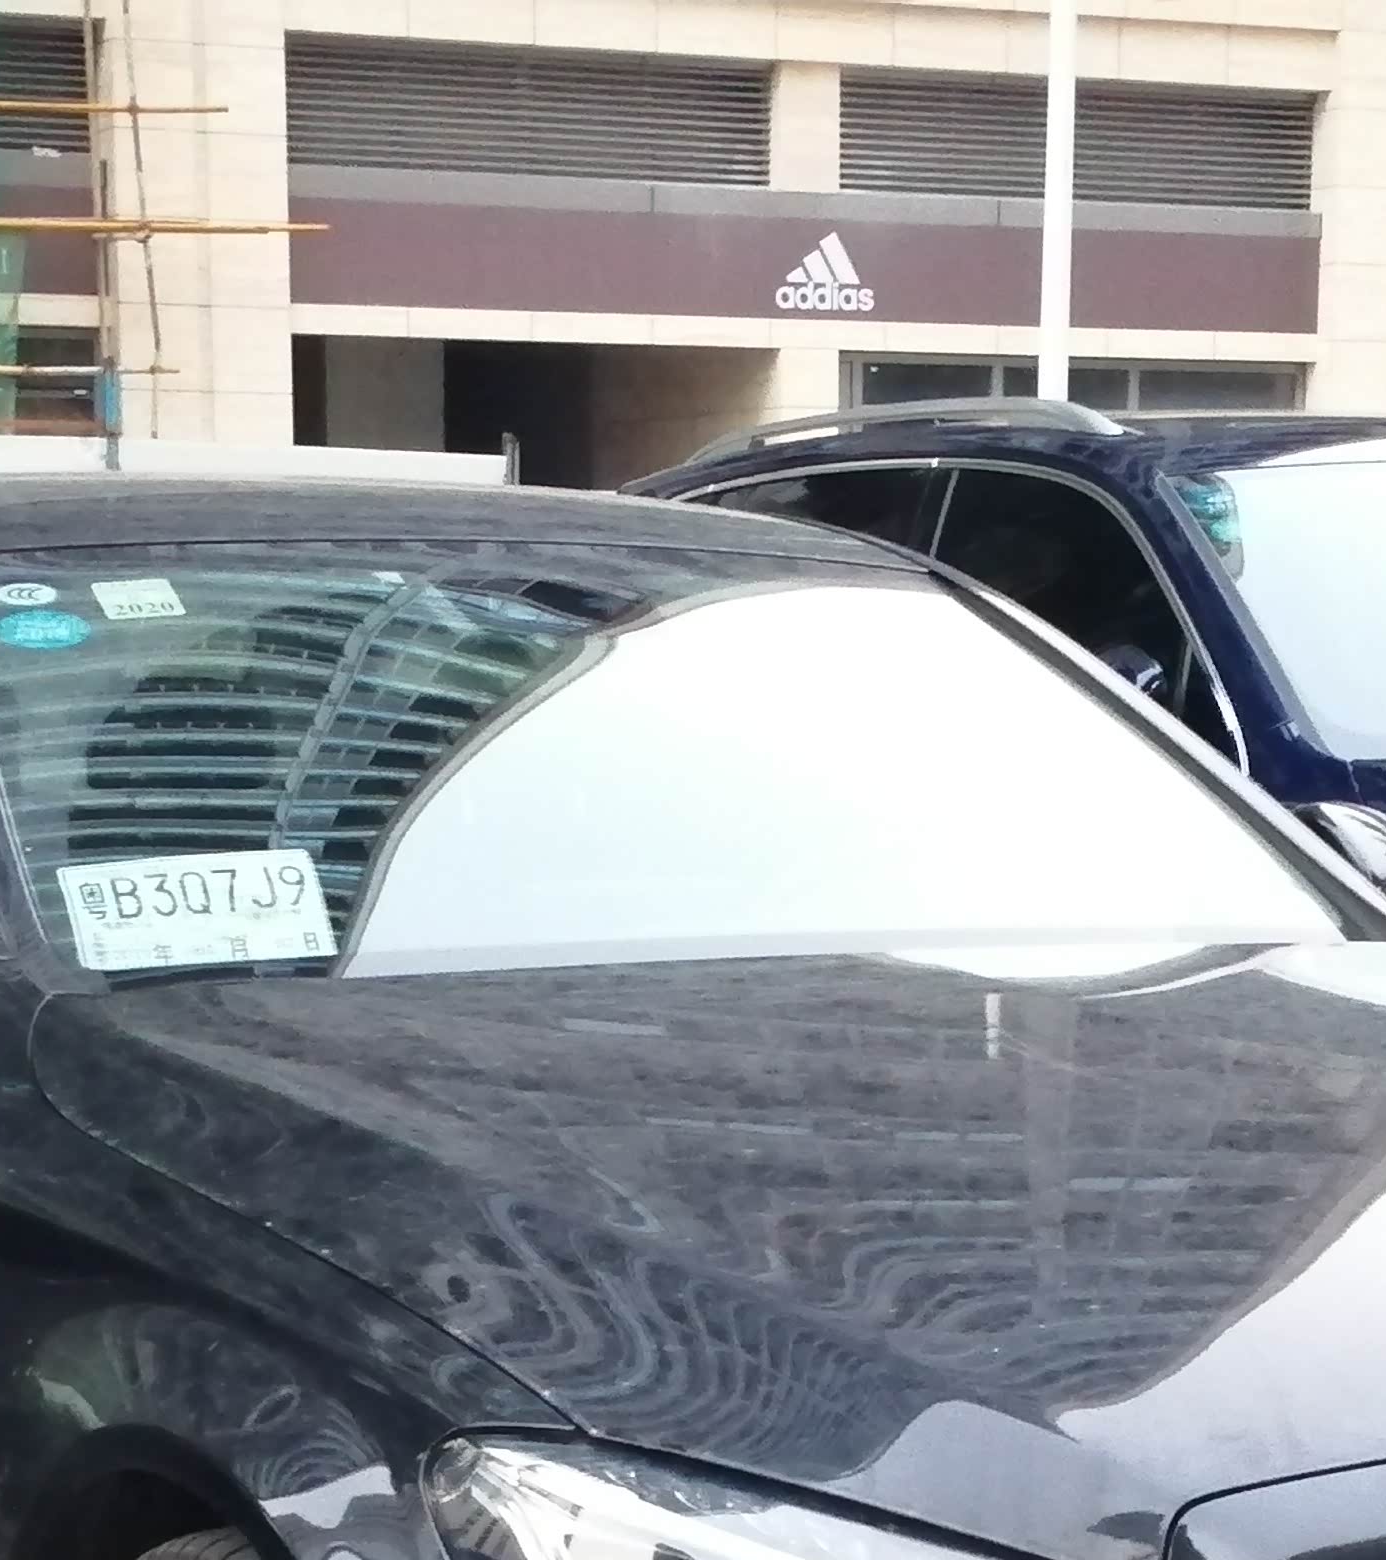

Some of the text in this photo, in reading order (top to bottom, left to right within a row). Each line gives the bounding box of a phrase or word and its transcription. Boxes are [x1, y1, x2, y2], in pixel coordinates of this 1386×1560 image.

[775, 280, 875, 312] addias
[116, 601, 175, 616] 2020
[152, 944, 174, 965] 年
[303, 931, 320, 952] 日
